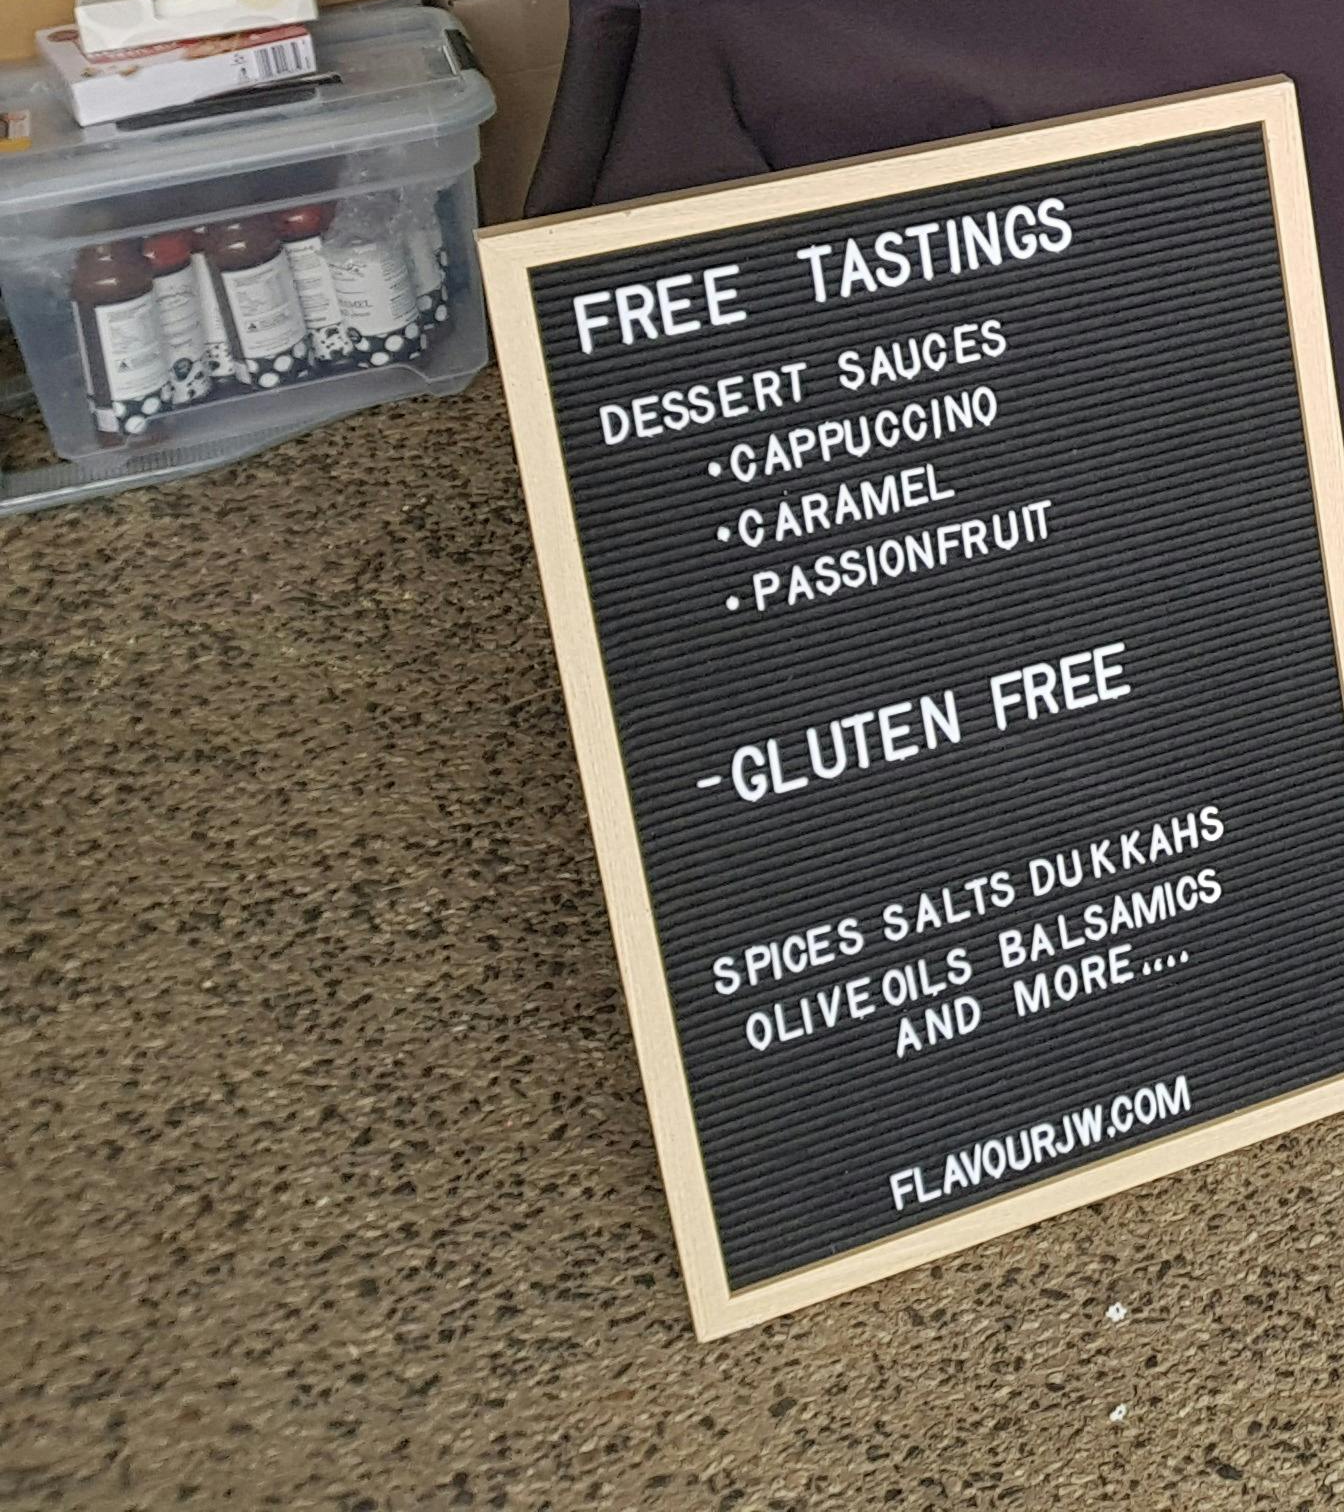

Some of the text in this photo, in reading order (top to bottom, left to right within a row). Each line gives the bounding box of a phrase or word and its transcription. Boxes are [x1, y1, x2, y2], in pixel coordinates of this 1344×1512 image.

[574, 199, 1071, 354] FREE TASTINGS
[600, 320, 1006, 444] DESSERT SAUCES
[991, 643, 1130, 730] FREE
[714, 807, 1223, 994] SPICES SALTS DUKKAHS
[747, 868, 1222, 1050] OLIVE OILS BALSAMICS
[897, 997, 980, 1057] AND
